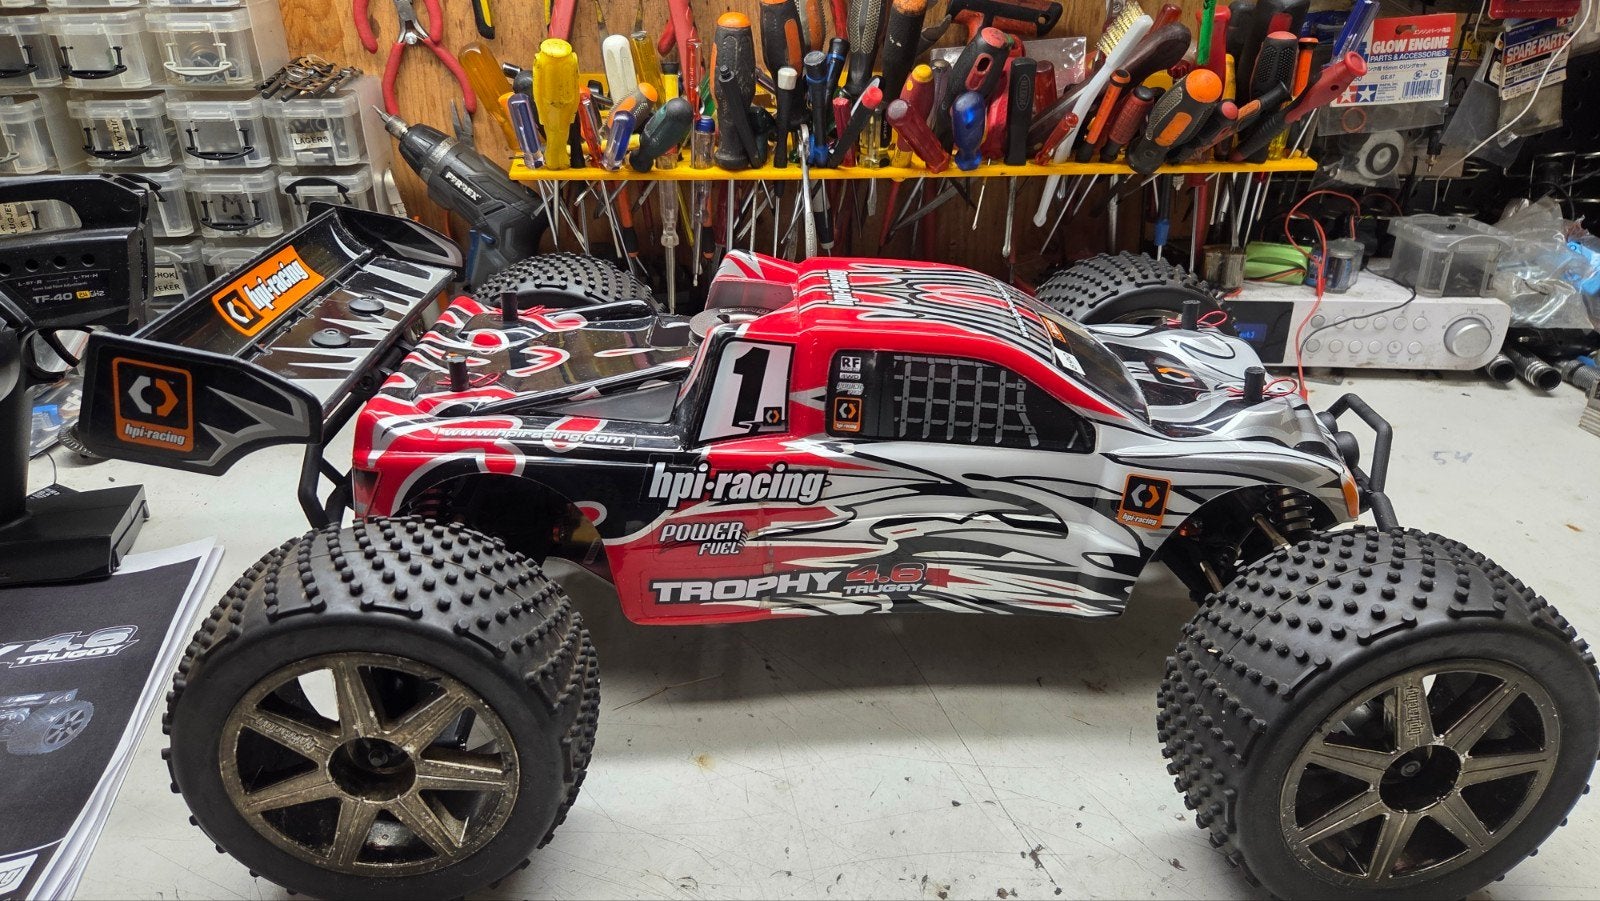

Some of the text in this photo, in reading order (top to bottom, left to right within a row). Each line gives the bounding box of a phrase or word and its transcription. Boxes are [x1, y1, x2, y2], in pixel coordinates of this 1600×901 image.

[1372, 36, 1450, 54] GLOW ENGINE
[1506, 39, 1539, 61] SPARE
[1538, 31, 1571, 51] PARTS
[1370, 54, 1393, 62] PARTS
[1400, 49, 1447, 60] ACCESSORIES
[294, 135, 329, 145] LAGERS
[32, 293, 73, 304] TF-40
[841, 357, 860, 368] RF
[732, 346, 771, 432] 1
[438, 427, 625, 445] www.hpiracing.com
[660, 522, 744, 542] POWER
[698, 542, 740, 555] FUEL
[845, 562, 925, 584] 4.6
[652, 570, 841, 602] TROPHY
[843, 583, 921, 595] TRUGGY
[16, 645, 124, 664] TRUGGY
